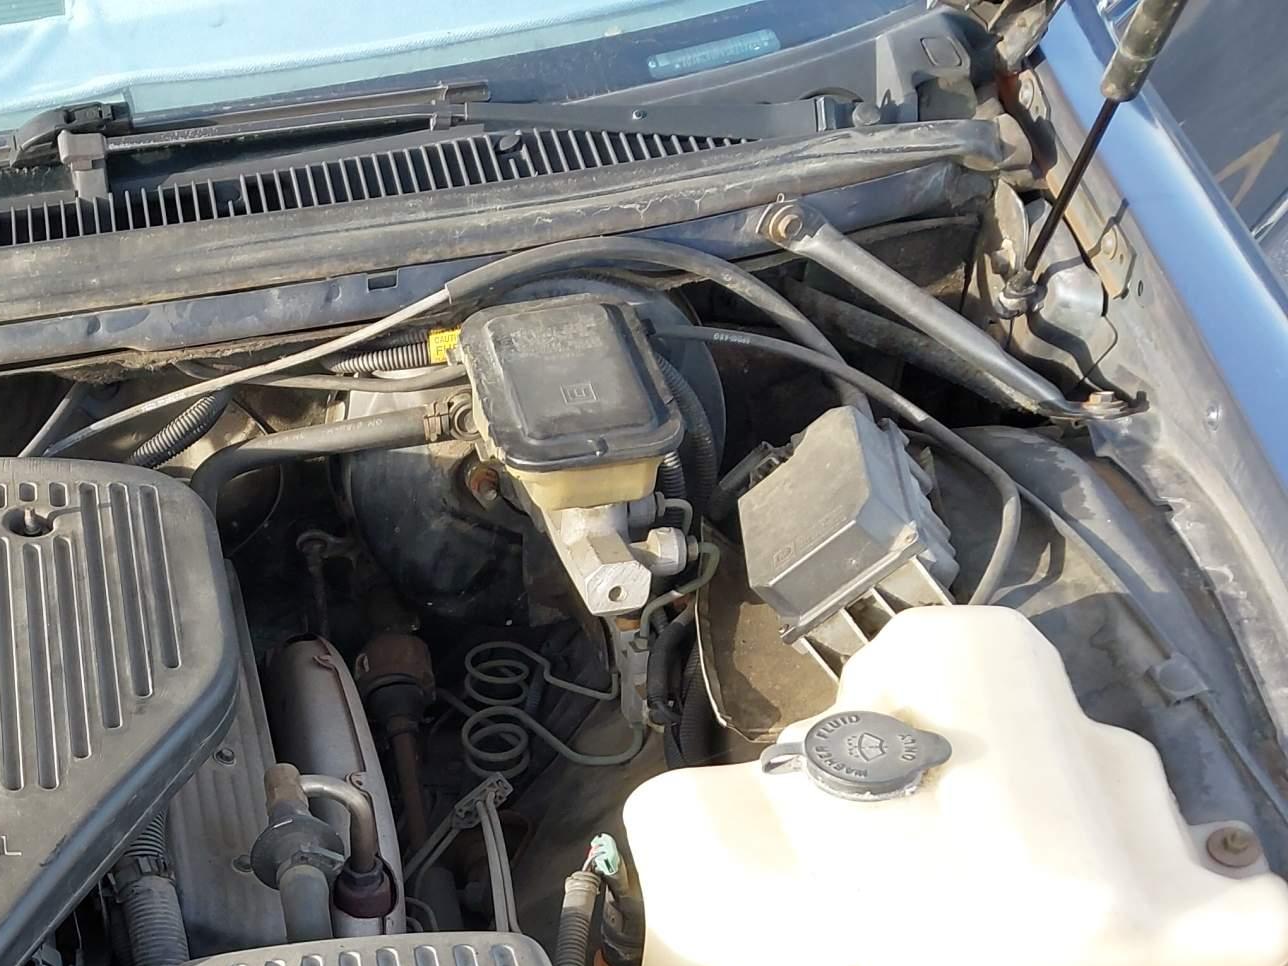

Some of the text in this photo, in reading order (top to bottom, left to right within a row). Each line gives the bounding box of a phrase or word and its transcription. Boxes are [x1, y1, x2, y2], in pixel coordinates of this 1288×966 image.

[815, 714, 917, 778] WASHER FLUID ONLY
